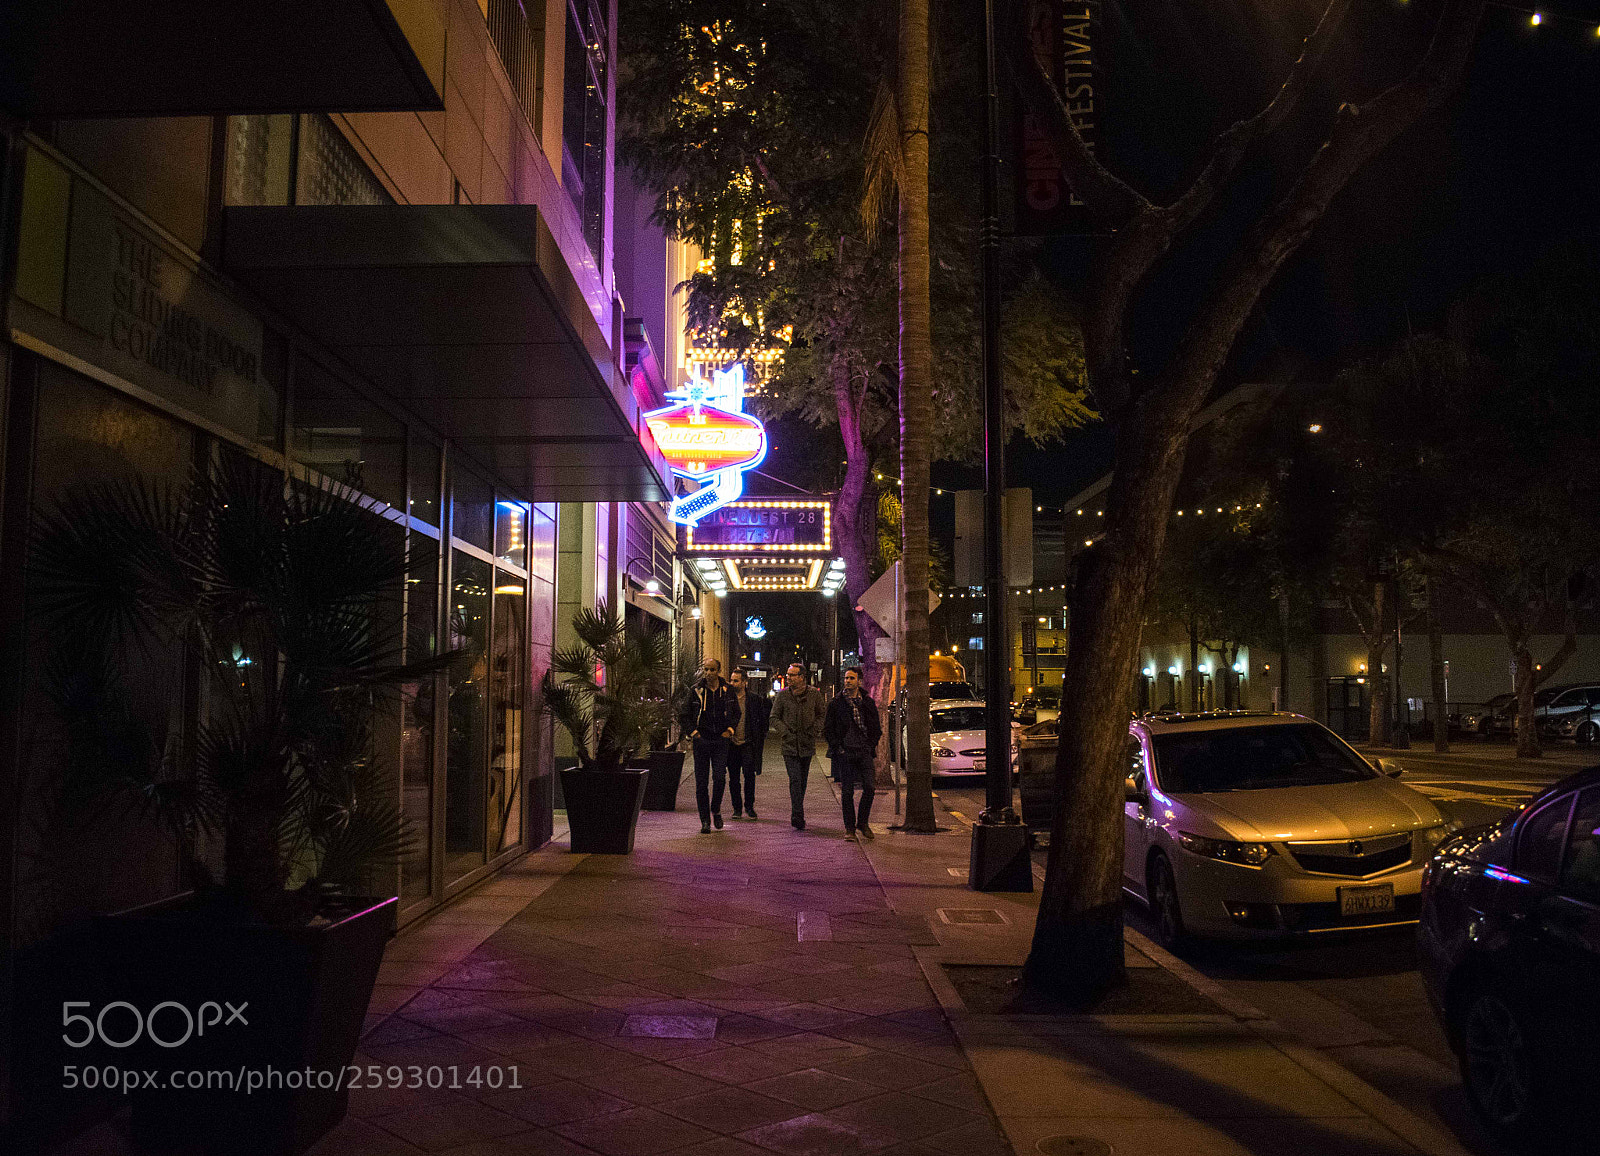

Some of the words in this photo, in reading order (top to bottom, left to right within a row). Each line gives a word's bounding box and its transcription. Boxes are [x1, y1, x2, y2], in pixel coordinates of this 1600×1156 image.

[1062, 8, 1095, 130] FESTIVAL
[117, 227, 162, 288] THE
[109, 312, 218, 396] COMPANY
[113, 271, 202, 353] SLIDING
[204, 324, 258, 384] DOOR
[702, 511, 790, 525] CINEQUEST
[798, 511, 816, 524] 28
